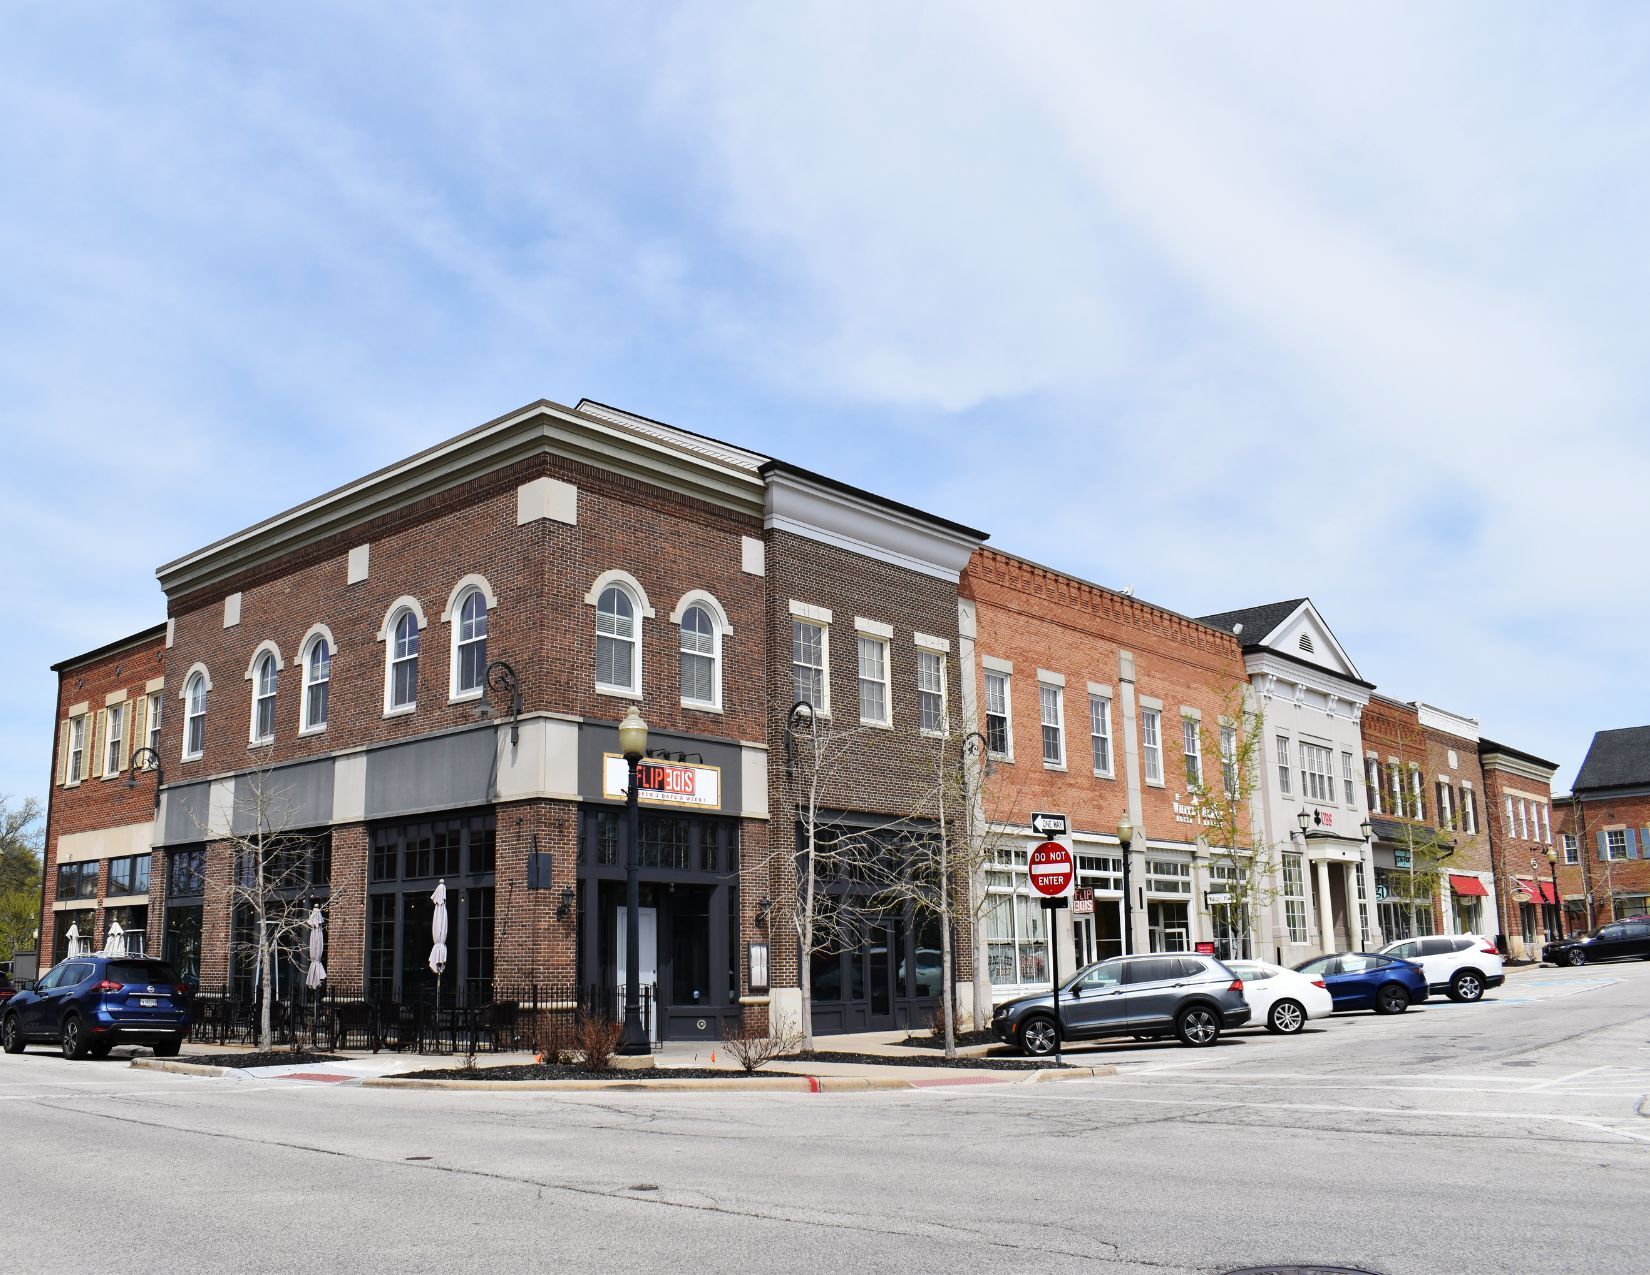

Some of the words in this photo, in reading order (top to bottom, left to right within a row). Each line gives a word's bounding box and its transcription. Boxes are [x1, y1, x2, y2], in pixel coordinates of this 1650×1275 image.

[636, 764, 664, 789] FLIP
[1042, 819, 1052, 829] ONE
[1053, 820, 1063, 829] WAY
[1321, 812, 1333, 826] UBS
[1034, 853, 1046, 862] DO
[1050, 851, 1066, 860] NOT
[1038, 876, 1064, 886] ENTER
[1074, 889, 1092, 900] FLIP
